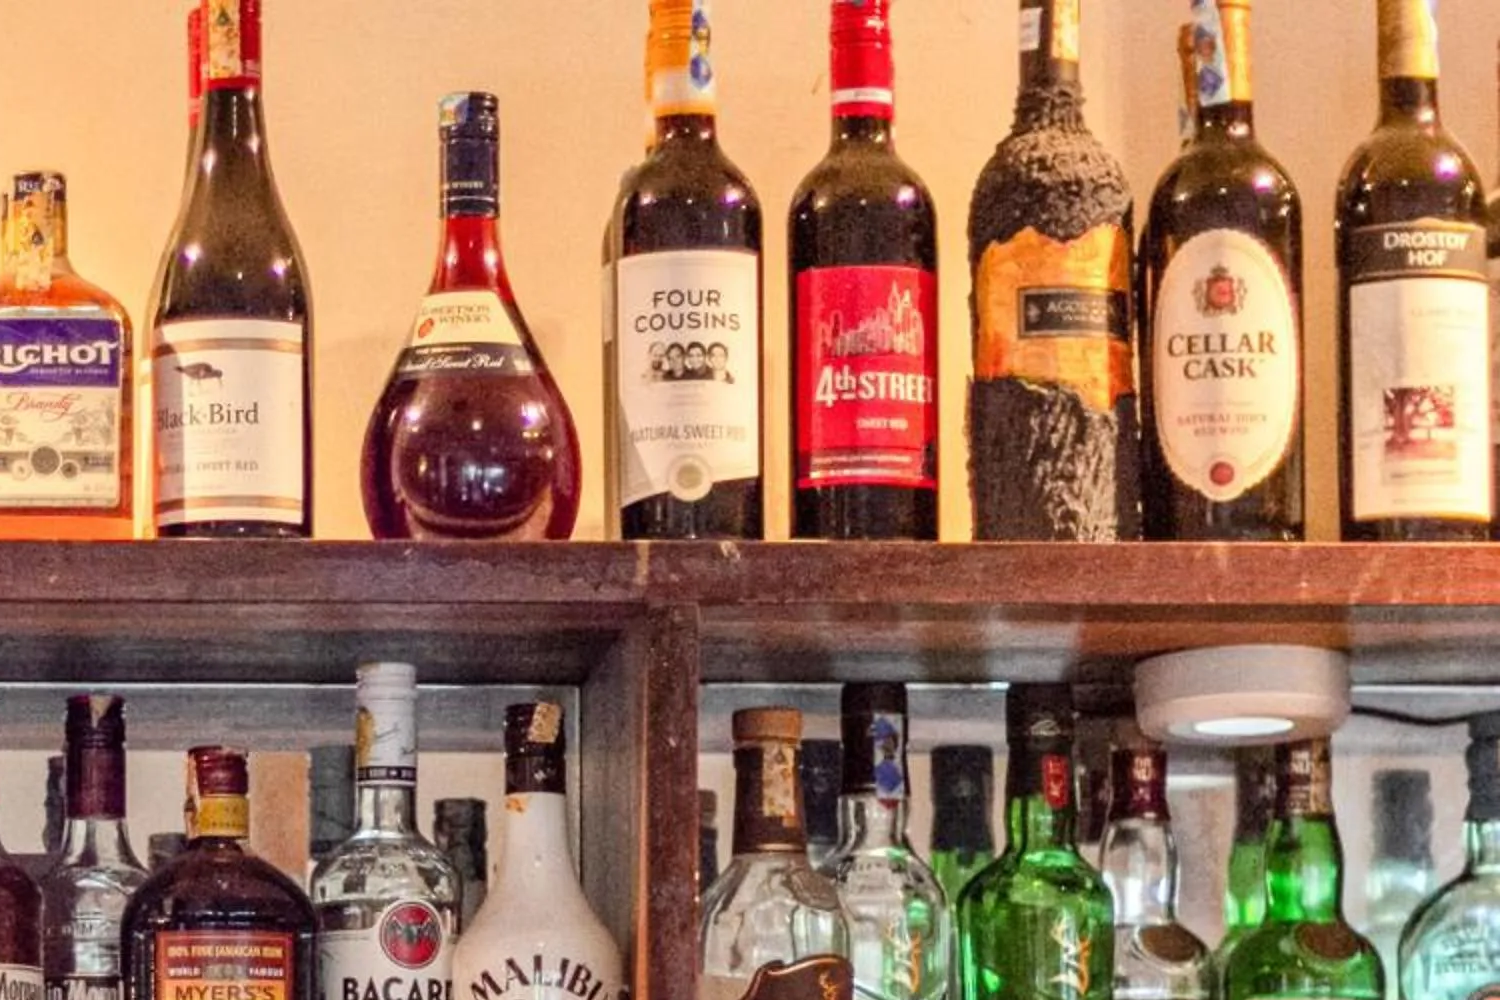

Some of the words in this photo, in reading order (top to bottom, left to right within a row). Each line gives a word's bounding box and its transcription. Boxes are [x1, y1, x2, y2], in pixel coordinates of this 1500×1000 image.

[1408, 250, 1448, 266] HOF
[652, 289, 723, 309] FOUR
[634, 310, 741, 334] COUSINS
[1167, 330, 1277, 357] CELLAR
[1183, 357, 1257, 381] CASK
[815, 364, 856, 408] 4th
